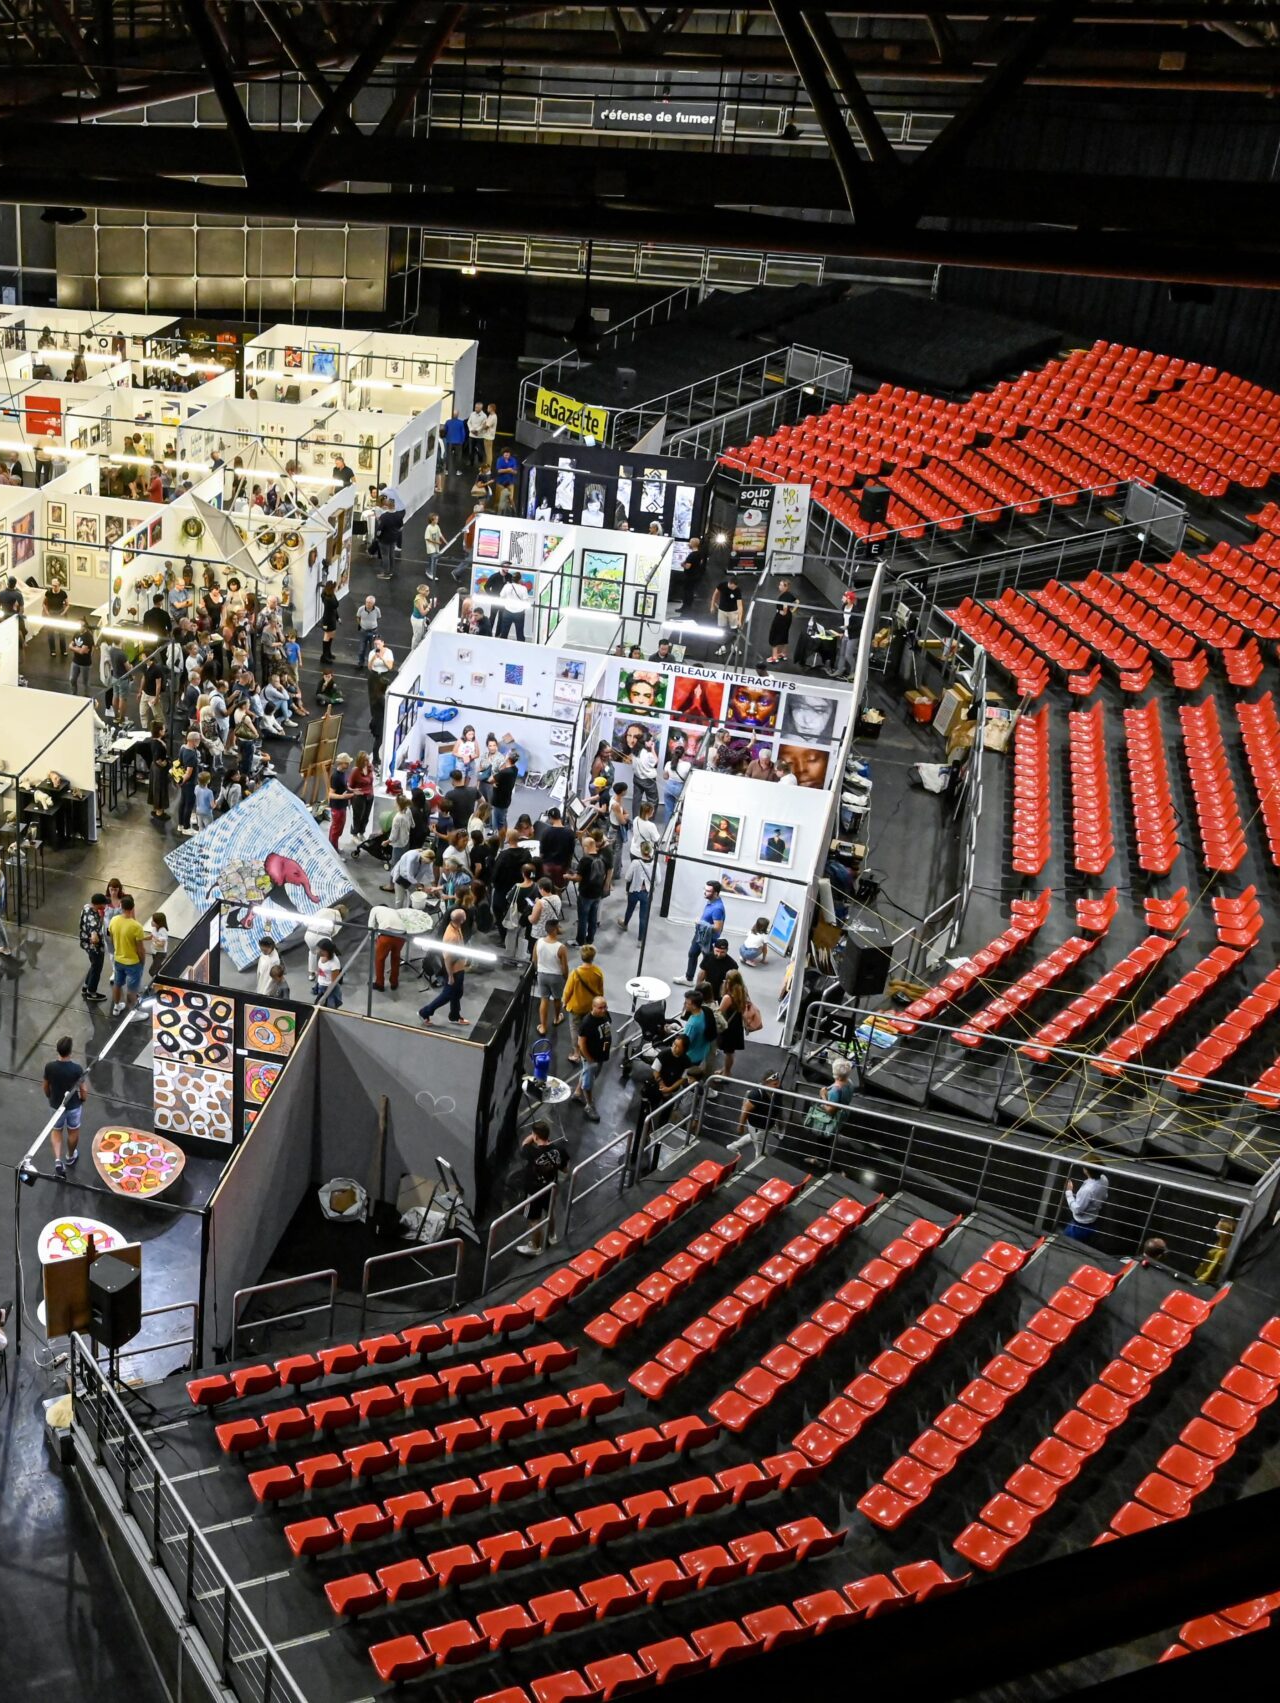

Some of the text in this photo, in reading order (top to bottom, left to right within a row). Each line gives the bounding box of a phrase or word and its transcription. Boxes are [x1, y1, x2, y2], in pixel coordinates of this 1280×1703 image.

[600, 109, 716, 124] défense de fumer
[751, 499, 770, 508] ART
[871, 544, 880, 554] E
[661, 663, 796, 691] TABLEAUX INTERACTIFS
